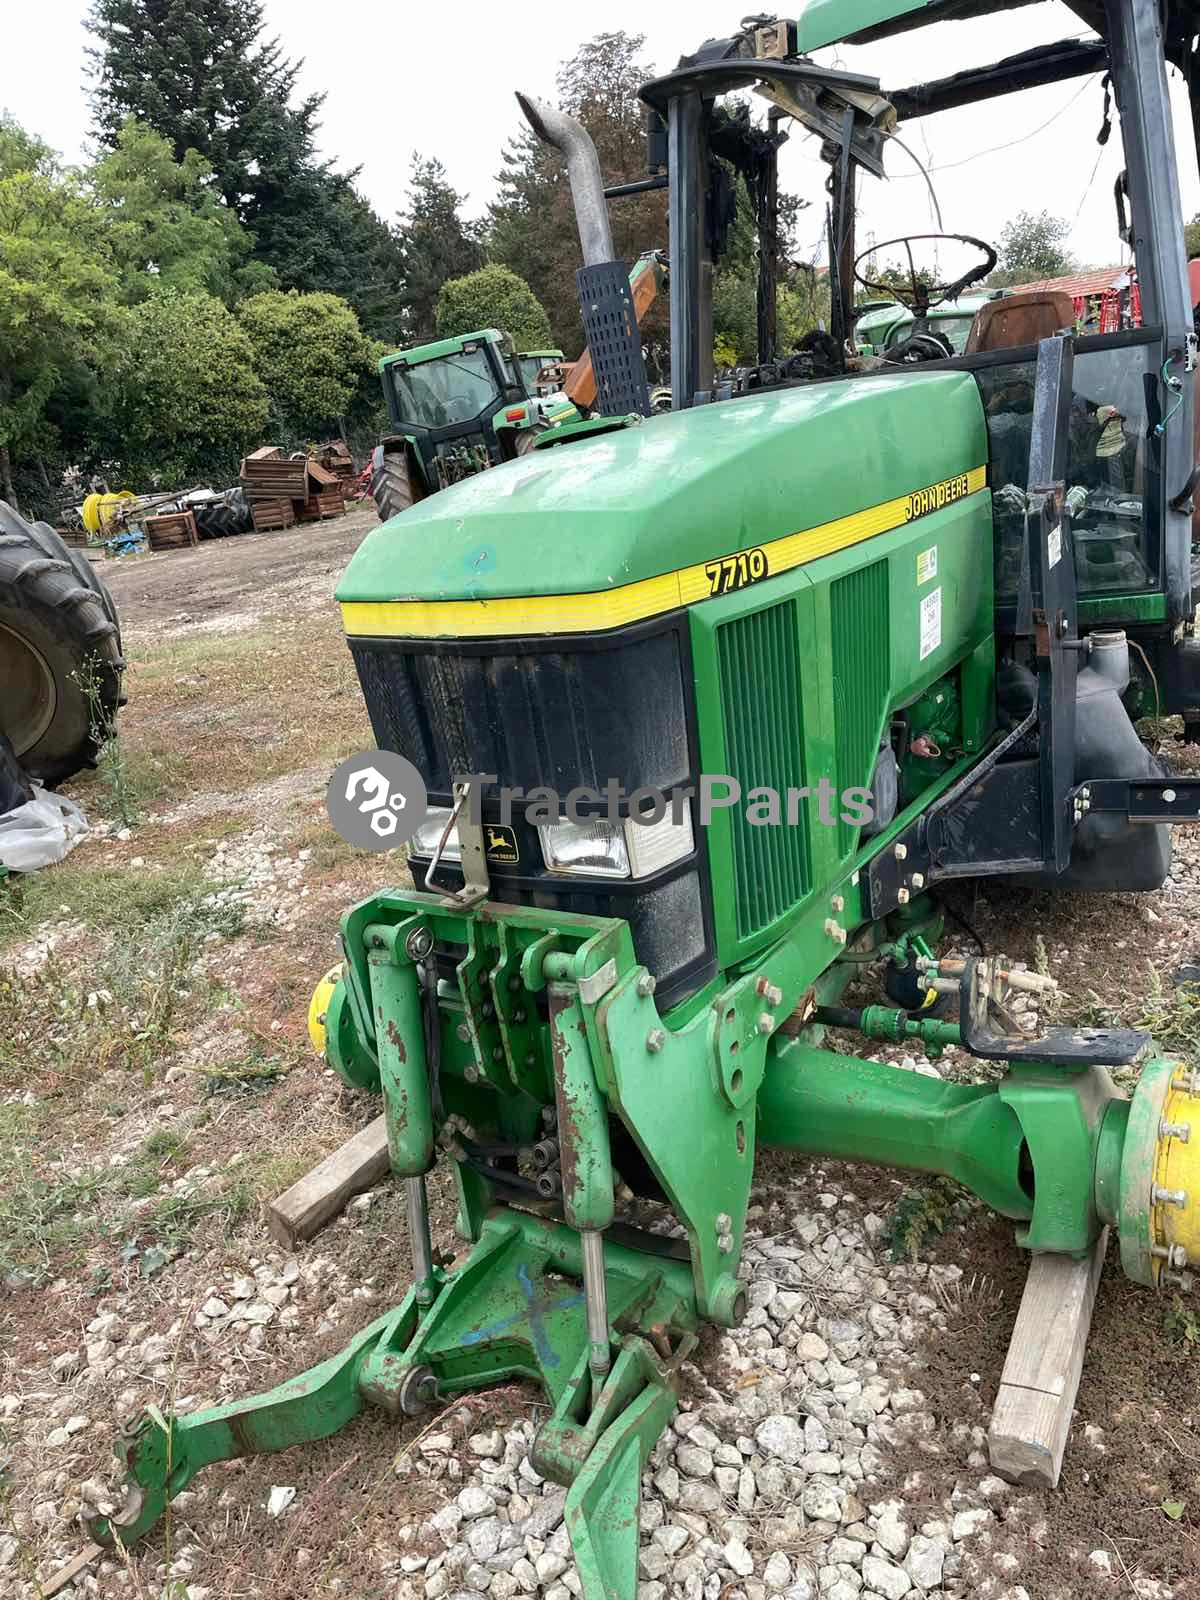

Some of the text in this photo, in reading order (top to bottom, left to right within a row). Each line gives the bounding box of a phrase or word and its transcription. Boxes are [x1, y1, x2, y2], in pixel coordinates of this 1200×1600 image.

[905, 474, 969, 521] JOHN DEERE
[705, 549, 768, 595] 7710
